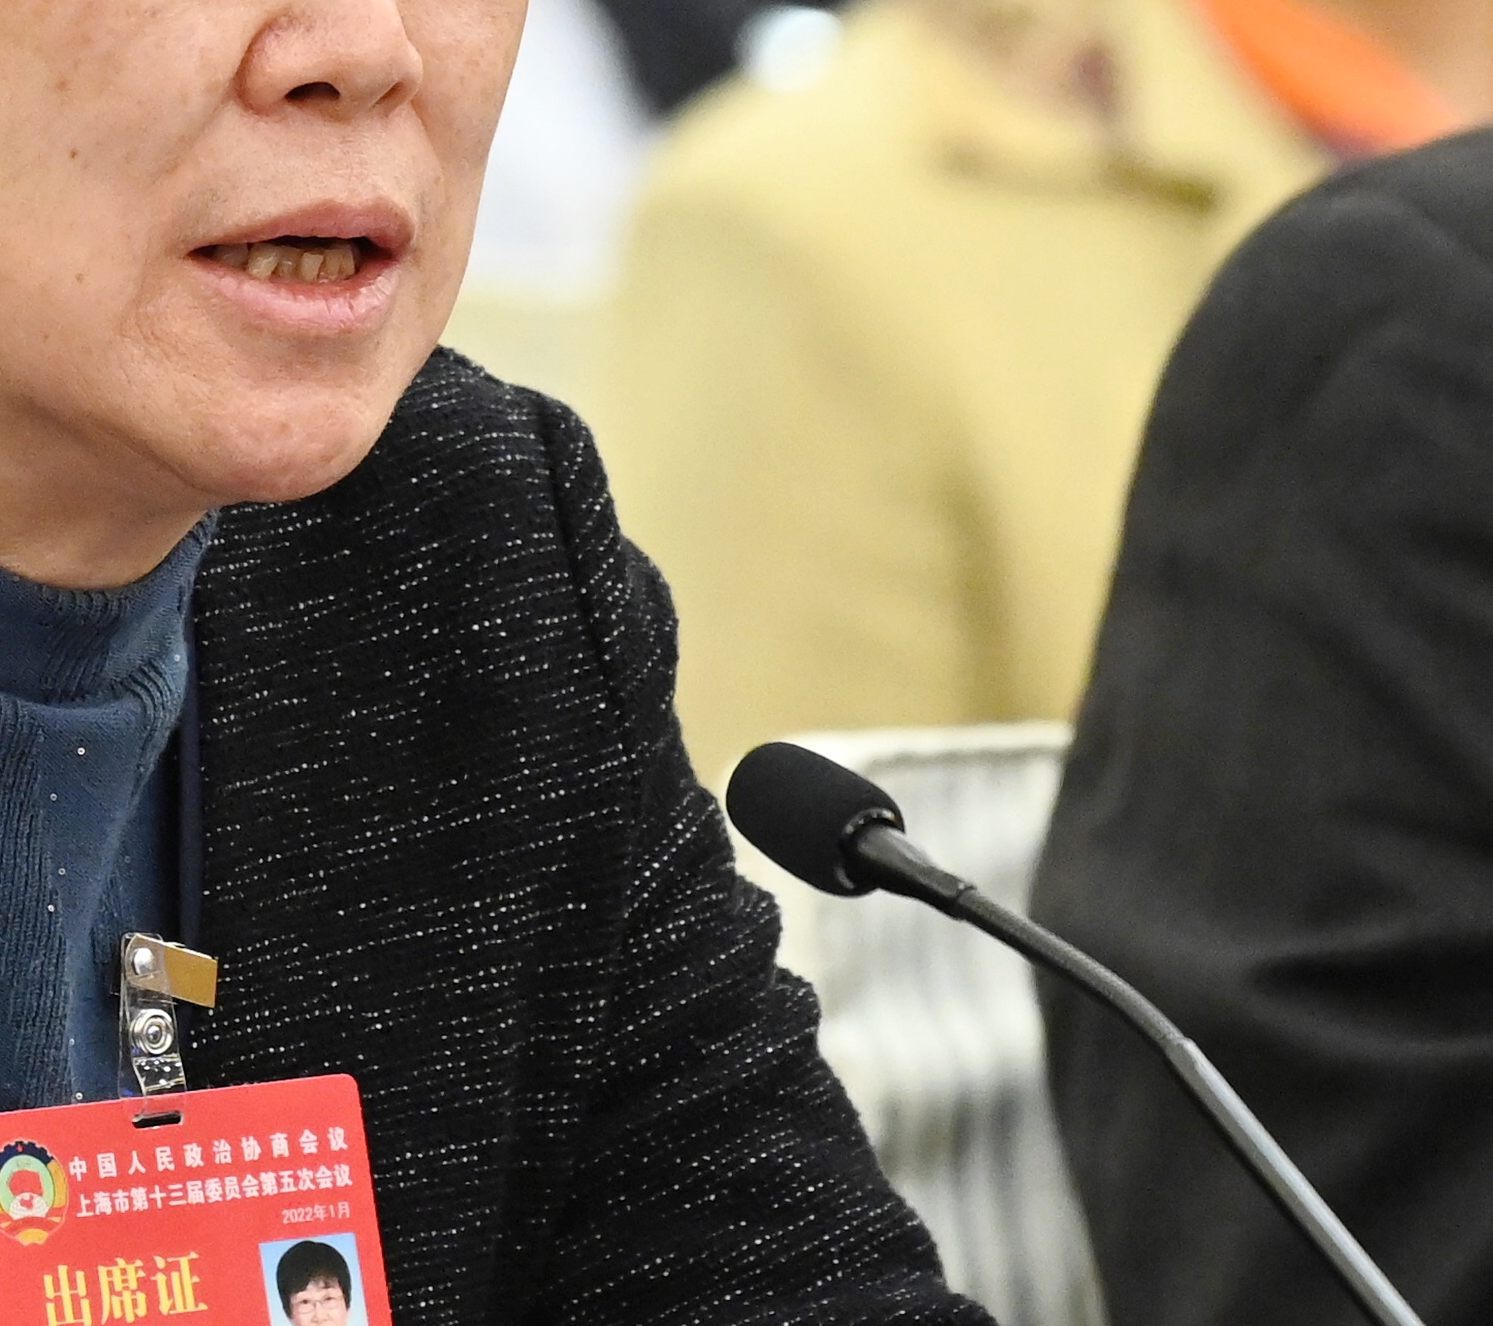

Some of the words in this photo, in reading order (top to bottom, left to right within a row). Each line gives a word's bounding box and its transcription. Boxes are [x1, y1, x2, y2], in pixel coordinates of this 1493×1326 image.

[69, 1126, 349, 1181] 中国人民政治协商会议
[76, 1164, 353, 1217] 上海市第十三届委员会第五次会议
[282, 1201, 351, 1224] 2022年1月
